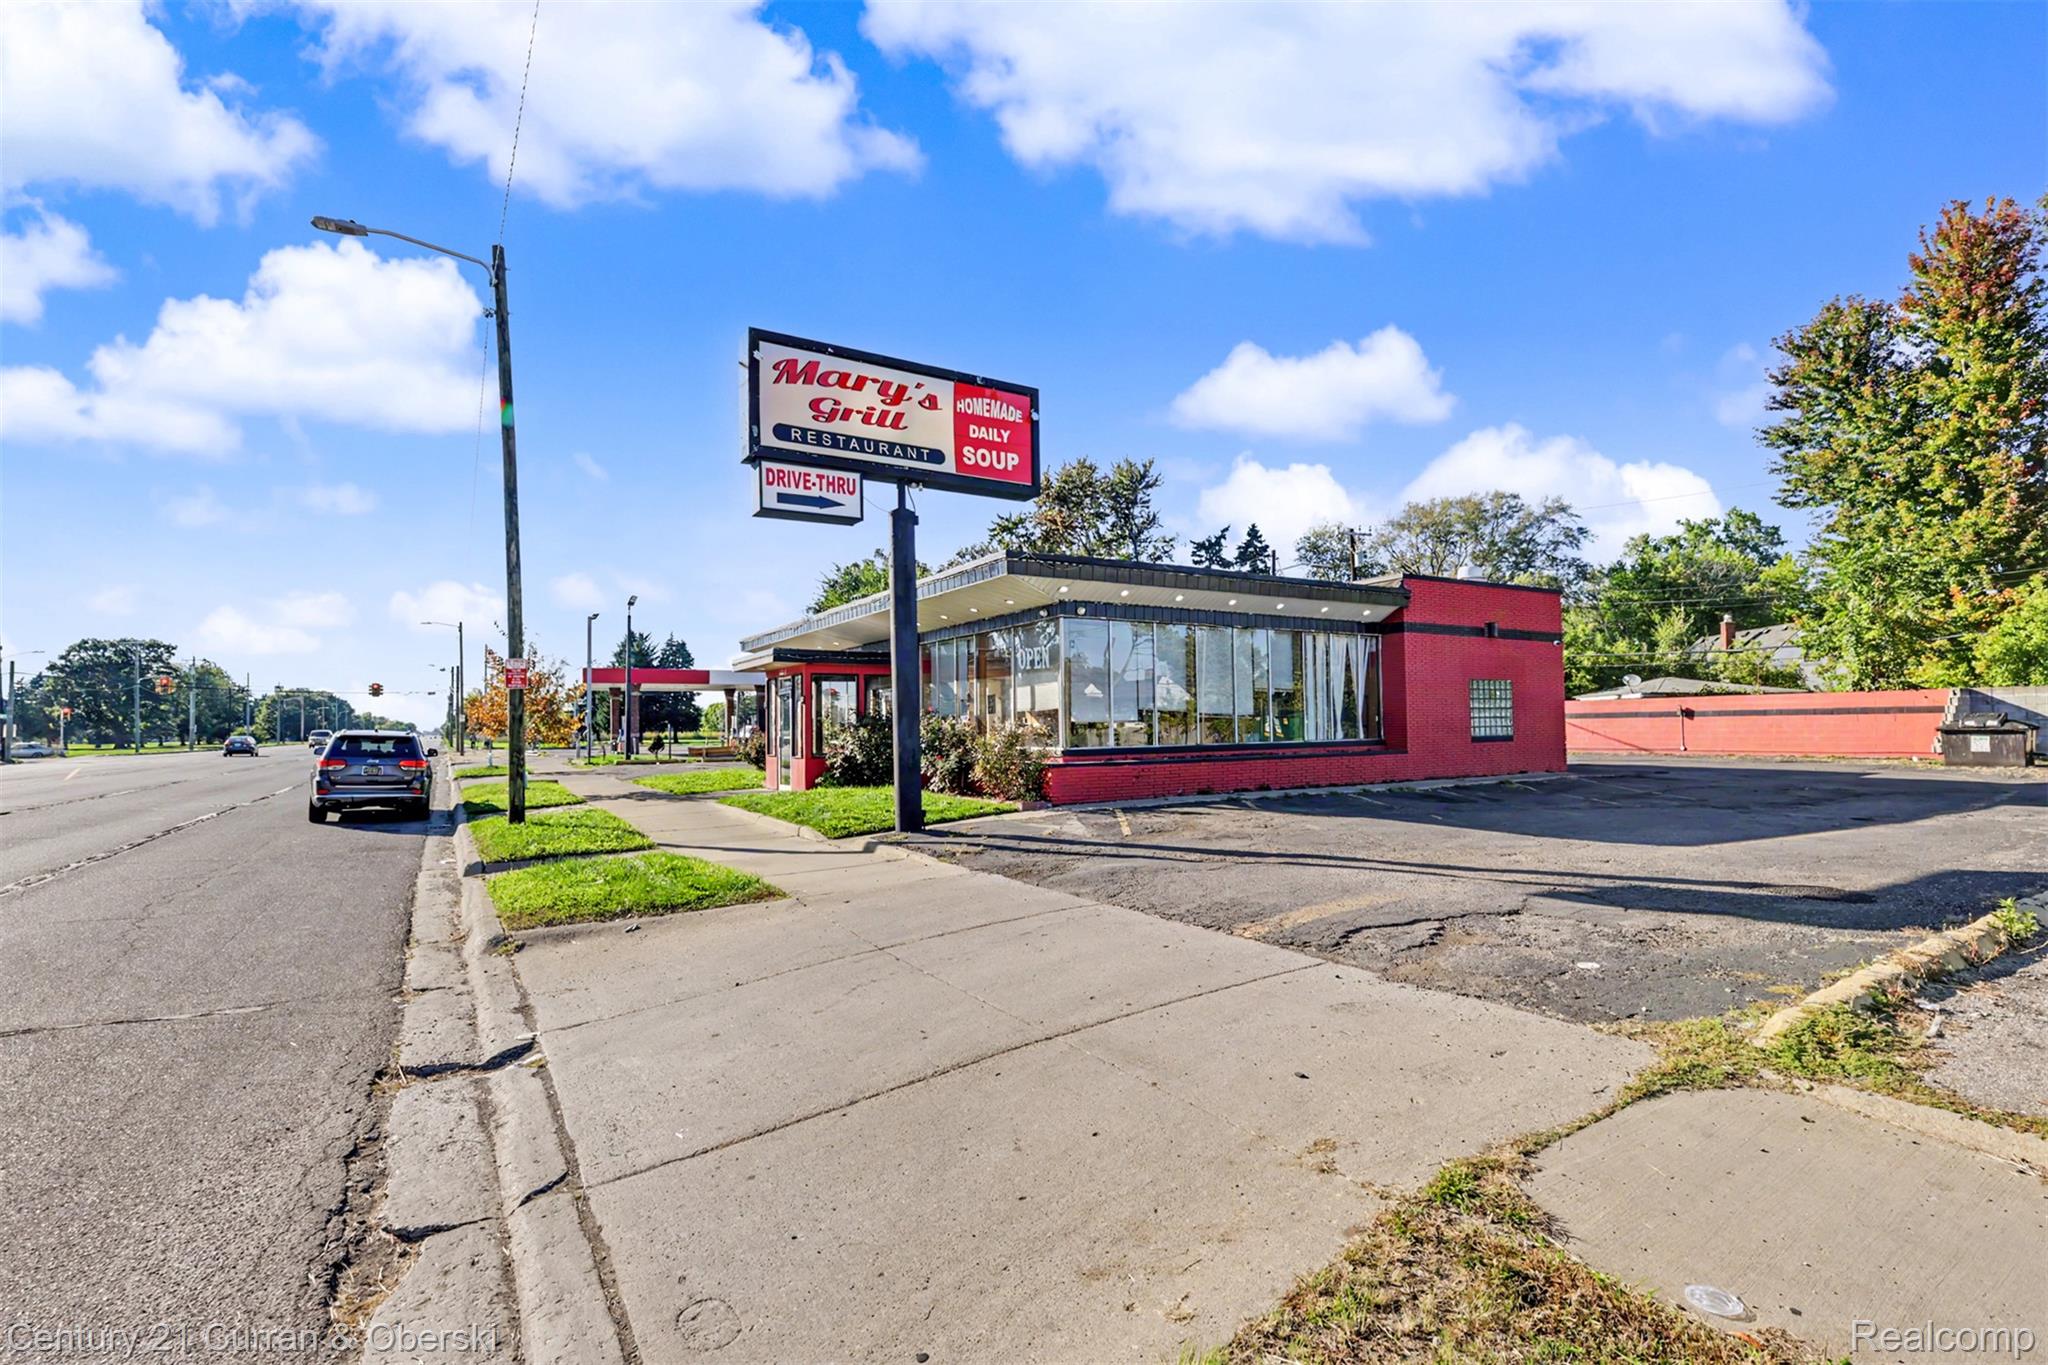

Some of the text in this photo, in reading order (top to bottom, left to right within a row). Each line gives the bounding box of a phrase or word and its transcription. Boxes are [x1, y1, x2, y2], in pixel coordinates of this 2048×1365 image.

[771, 357, 943, 411] Mary's
[808, 397, 909, 431] Grill
[956, 397, 1023, 424] HOMEMADE
[790, 428, 931, 462] RESTAURANT
[969, 424, 1011, 444] DAILY
[962, 446, 1020, 471] SOUP
[765, 467, 857, 496] DRIVE-THRU
[1017, 646, 1050, 670] OPEN
